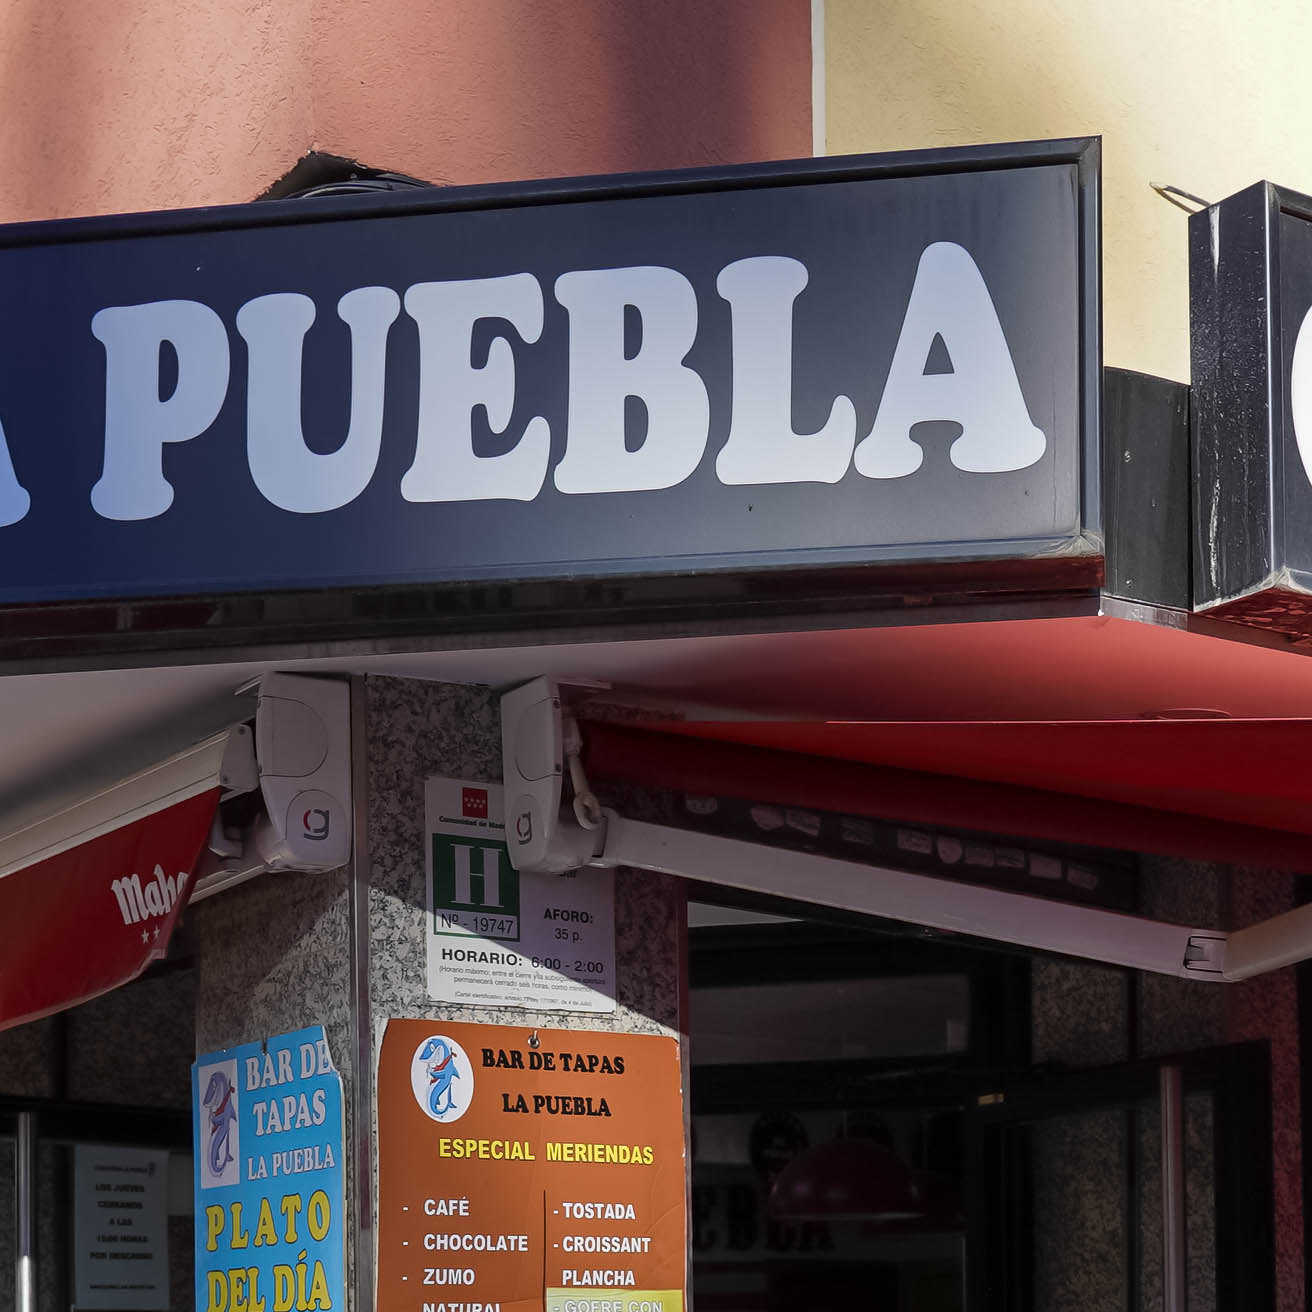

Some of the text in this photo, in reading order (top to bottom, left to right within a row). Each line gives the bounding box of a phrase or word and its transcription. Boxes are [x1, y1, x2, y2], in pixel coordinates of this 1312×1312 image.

[90, 241, 1047, 522] PUEBLA
[473, 917, 513, 935] 19747
[543, 907, 593, 924] AFORO:
[554, 927, 583, 943] 35 p.
[441, 948, 523, 967] HORARIO:
[531, 955, 561, 971] 6:00
[574, 960, 604, 974] 2:00
[244, 1037, 333, 1092] BAR DE
[482, 1048, 625, 1075] BAR DE TAPAS
[252, 1088, 326, 1137] TAPAS
[502, 1093, 612, 1117] LA PUEBLA
[247, 1142, 335, 1182] LA PUEBLA
[439, 1138, 654, 1165] ESPECIAL MERIENDAS
[424, 1196, 470, 1217] CAFÉ
[563, 1202, 636, 1220] TOSTADA
[206, 1188, 332, 1252] PLATO
[423, 1234, 529, 1252] CHOCOLATE
[562, 1236, 651, 1253] CROISSANT
[423, 1268, 475, 1285] ZUMO
[562, 1269, 635, 1286] PLANCHA
